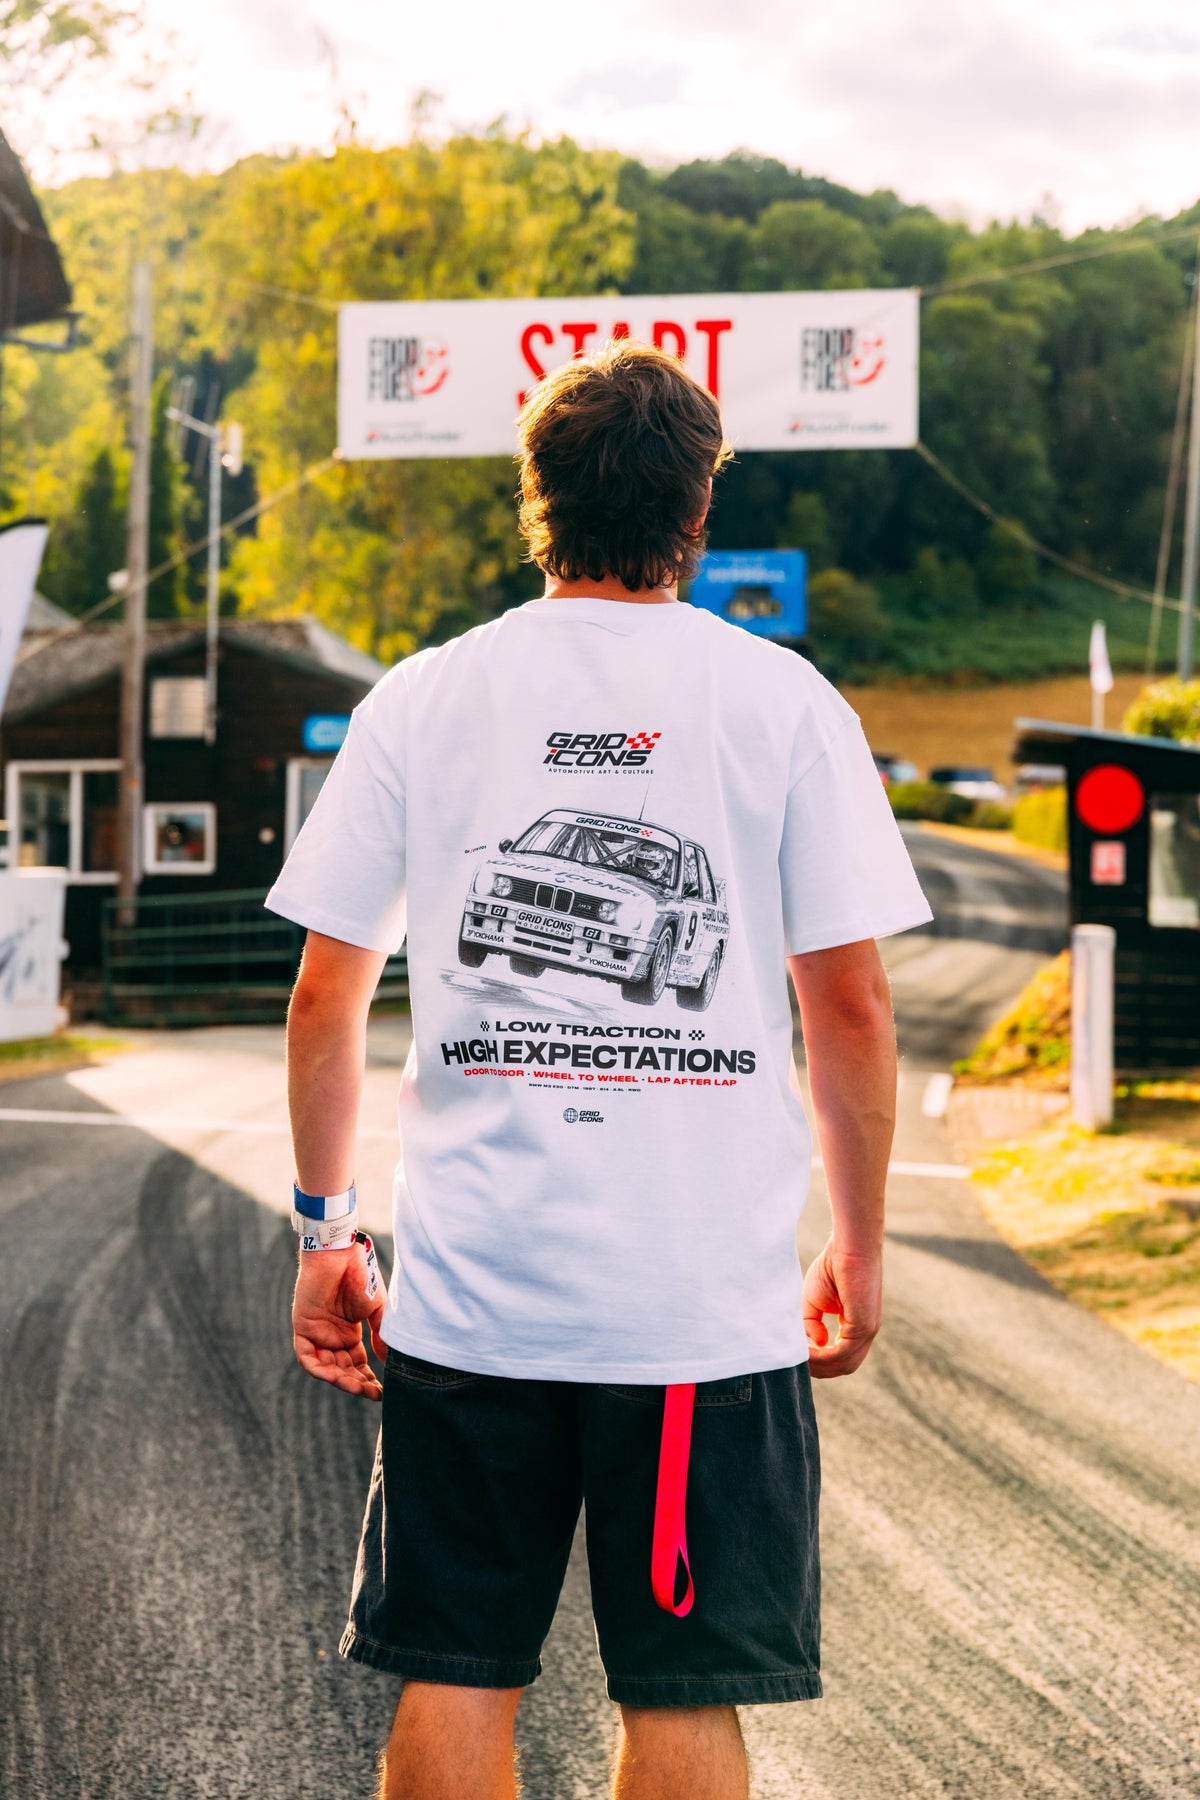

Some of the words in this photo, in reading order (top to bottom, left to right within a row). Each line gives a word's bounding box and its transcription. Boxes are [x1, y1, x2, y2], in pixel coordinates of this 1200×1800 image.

[546, 732, 628, 750] GRID
[492, 906, 506, 916] GI
[517, 921, 571, 938] MOTORSPORT
[518, 911, 542, 925] GRID
[542, 917, 573, 933] ICONS
[684, 910, 698, 951] 9
[473, 930, 504, 943] YOKOHAMA
[584, 928, 600, 939] GI
[588, 957, 627, 973] YOKOHAMA
[495, 1021, 552, 1033] LOW
[556, 1023, 681, 1040] TRACTION
[441, 1039, 499, 1066] HIGH
[503, 1040, 756, 1075] EXPECTATIONS
[464, 1068, 489, 1076] DOOR
[489, 1068, 497, 1076] TO
[498, 1069, 525, 1077] DOOR
[533, 1070, 575, 1080] WHEEL
[597, 1074, 639, 1083] WHEEL
[673, 1077, 711, 1085] AFTER
